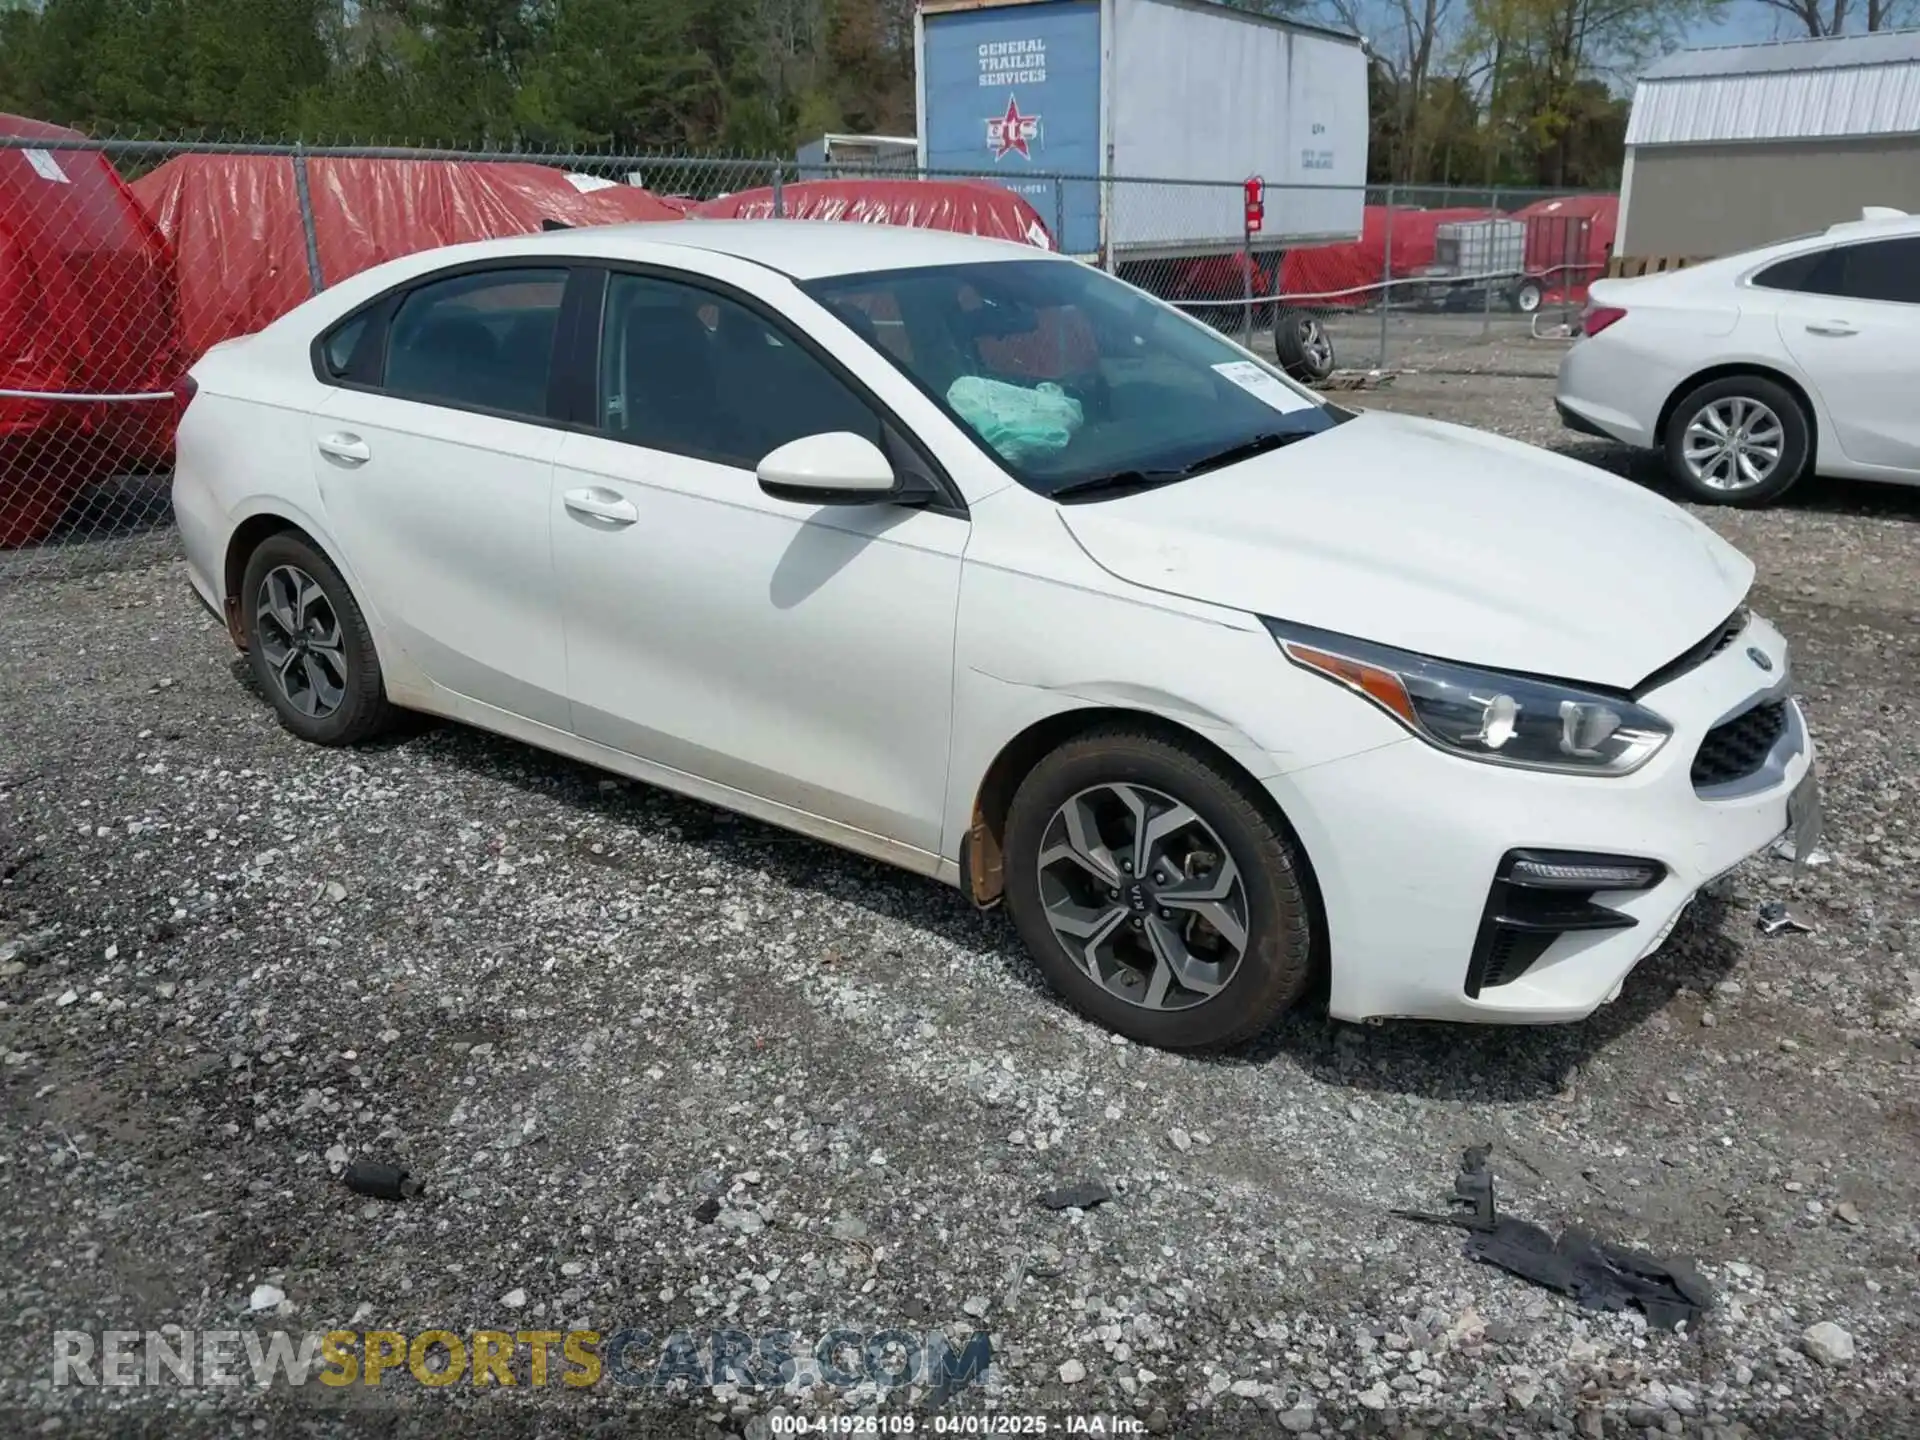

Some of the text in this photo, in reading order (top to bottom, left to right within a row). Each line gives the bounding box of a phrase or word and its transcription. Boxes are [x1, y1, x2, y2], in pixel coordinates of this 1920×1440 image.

[979, 39, 1046, 56] GENERAL
[979, 53, 1046, 71] TRAILER
[979, 69, 1046, 86] SERVICES
[1131, 884, 1145, 910] KIA
